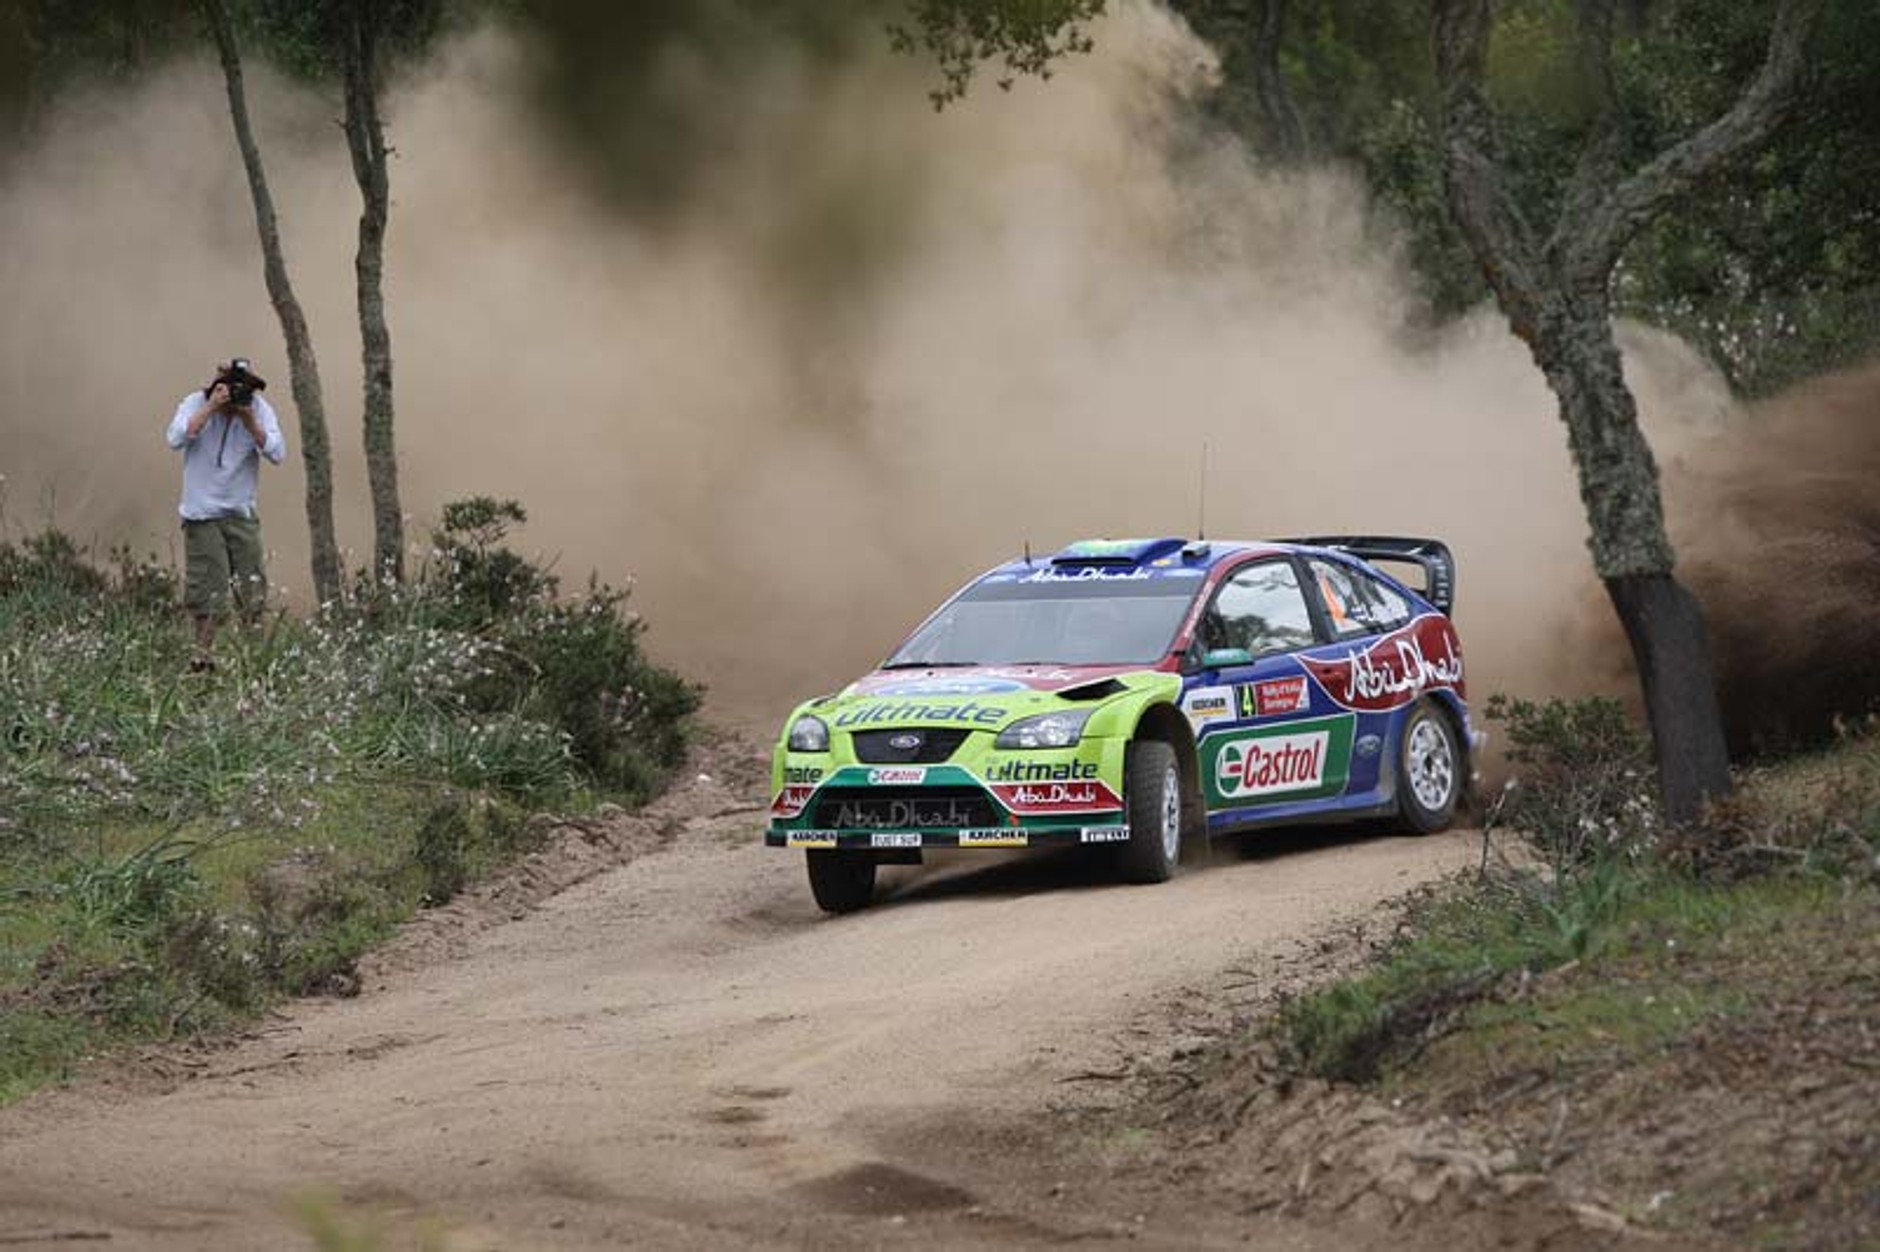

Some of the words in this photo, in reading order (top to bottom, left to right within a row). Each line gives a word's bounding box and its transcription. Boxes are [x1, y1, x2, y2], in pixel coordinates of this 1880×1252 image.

[1018, 567, 1082, 583] Abu
[1080, 566, 1153, 582] Dhabi
[1344, 647, 1396, 702] Abu
[836, 702, 1008, 727] ultimate
[1242, 684, 1253, 717] 4
[1243, 738, 1321, 788] Castrol
[832, 800, 884, 828] Abu
[888, 800, 971, 828] Dhabi
